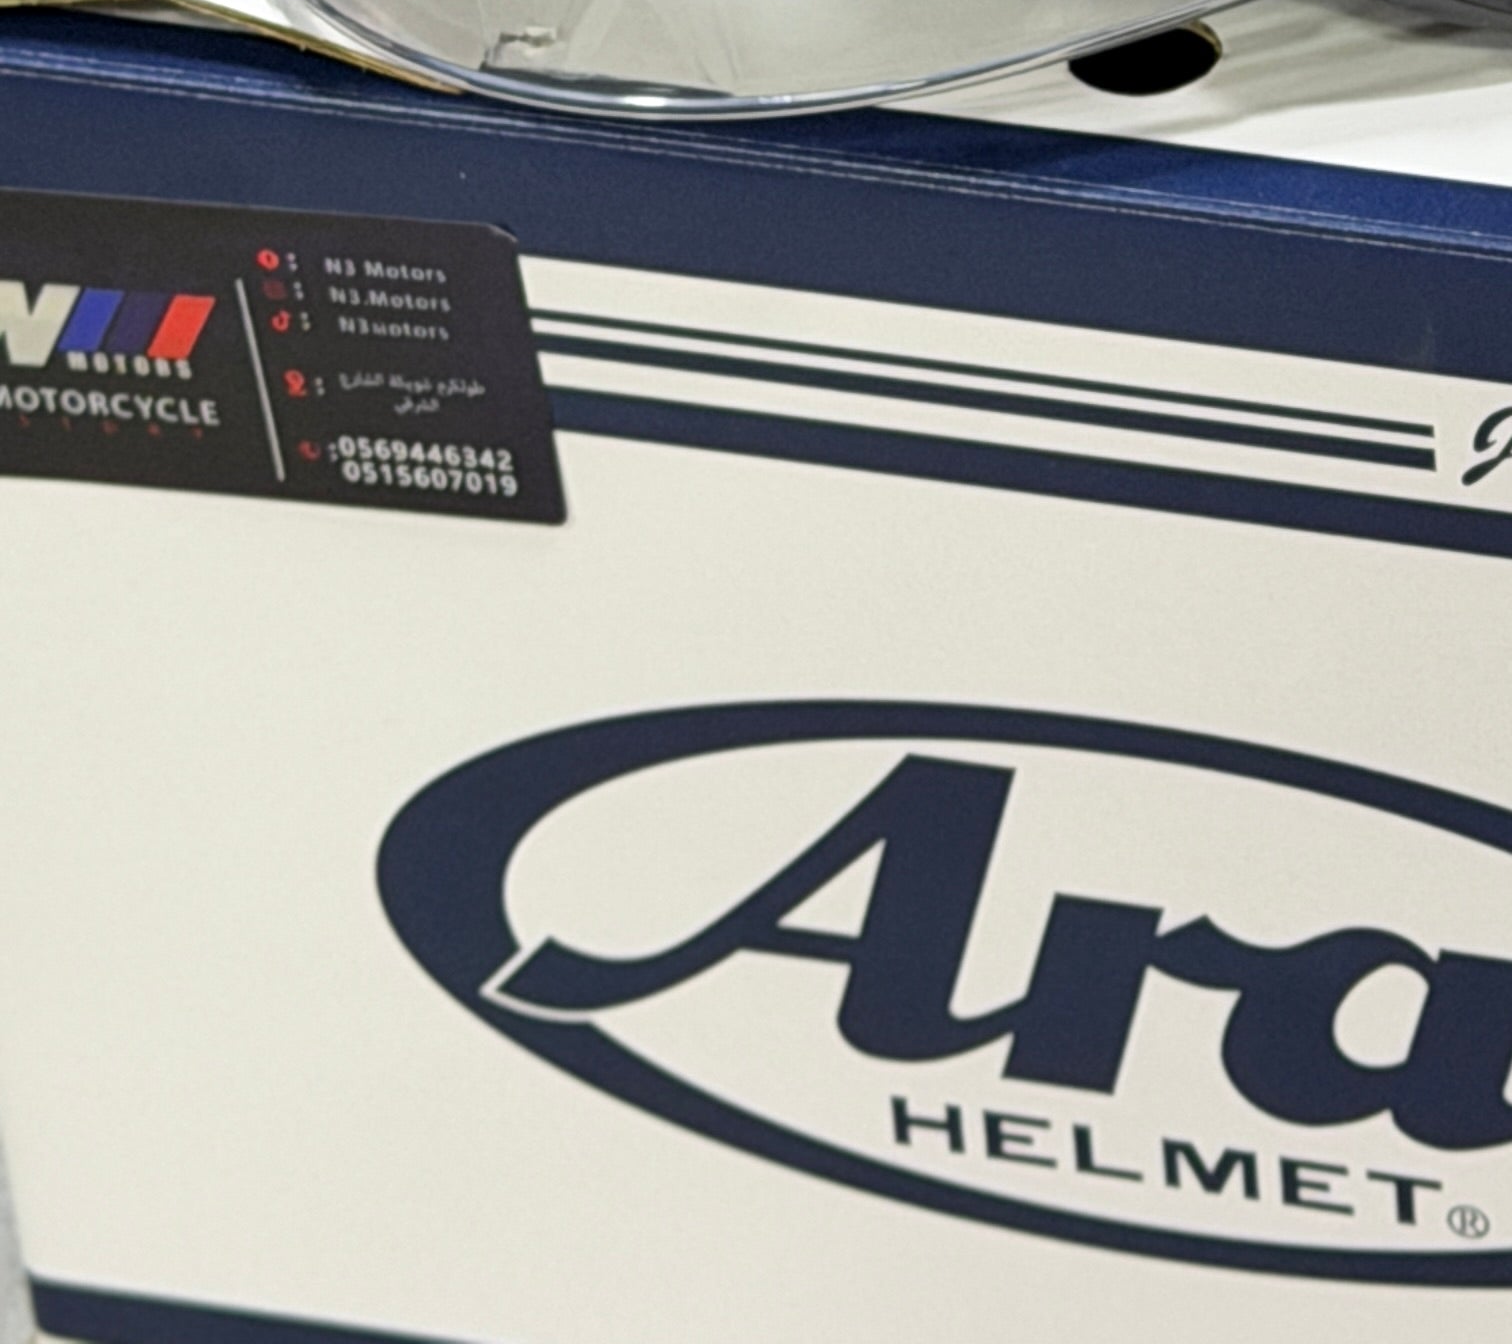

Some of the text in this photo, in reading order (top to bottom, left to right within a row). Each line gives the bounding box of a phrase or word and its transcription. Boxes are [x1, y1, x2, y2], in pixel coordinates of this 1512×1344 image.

[325, 257, 447, 284] N3 Motors
[330, 286, 451, 312] N3.Motors
[338, 435, 514, 472] 0569446342
[342, 460, 518, 497] 0515607019
[888, 1093, 1443, 1231] HELMET
